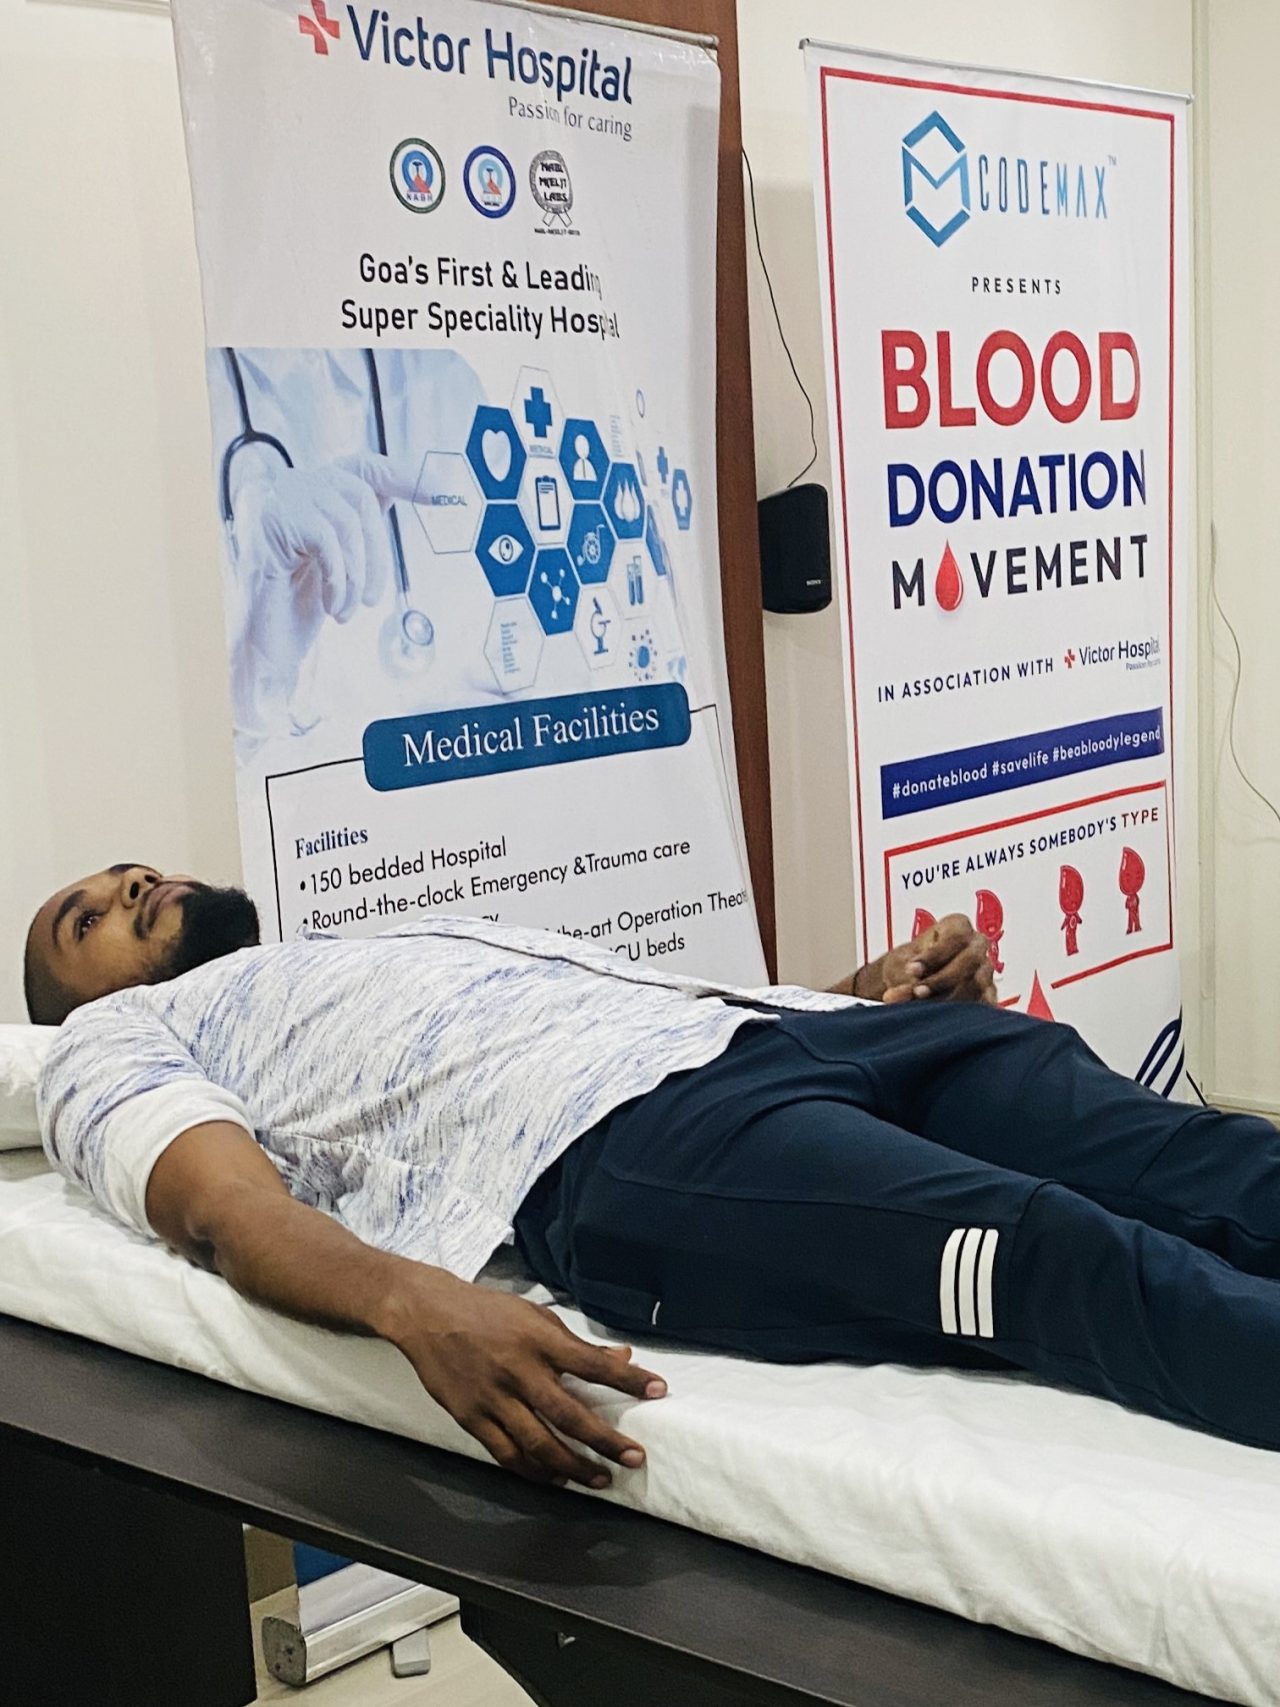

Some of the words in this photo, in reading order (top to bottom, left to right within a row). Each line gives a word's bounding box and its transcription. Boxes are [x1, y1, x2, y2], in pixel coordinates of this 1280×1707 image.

[346, 4, 470, 76] Victor
[485, 28, 632, 105] Hospital
[564, 105, 583, 129] for
[588, 114, 632, 142] caring
[978, 154, 1108, 219] CODEMAX
[359, 252, 429, 285] Goa's
[437, 257, 493, 288] First
[502, 260, 518, 289] &
[971, 276, 1061, 295] PRESENTS
[341, 299, 418, 337] Super
[428, 301, 543, 340] Speciality
[550, 305, 620, 341] Hospal
[880, 329, 1142, 430] BLOOD
[887, 448, 1148, 528] DONATION
[877, 685, 894, 703] IN
[902, 665, 1011, 699] ASSOCIATION
[1017, 658, 1053, 680] WITH
[1078, 645, 1115, 666] Victor
[402, 716, 523, 768] Medical
[532, 702, 660, 748] Facilities
[892, 763, 988, 799] #donateblood
[992, 749, 1049, 777] #savelife
[1052, 726, 1160, 764] #beabloodylegend
[295, 827, 369, 859] Facilities
[310, 867, 342, 894] 150
[348, 851, 424, 885] bedded
[431, 835, 506, 870] Hospital
[901, 859, 961, 891] YOU'RE
[965, 842, 1025, 874] ALWAYS
[1029, 815, 1117, 856] SOMEBODY'S
[1121, 806, 1159, 829] TYPE
[311, 880, 465, 930] Round-the-clock
[471, 865, 568, 897] Emergency
[573, 845, 648, 878] &Trauma
[653, 838, 691, 860] care
[617, 900, 703, 934] Operation
[647, 932, 685, 958] beds
